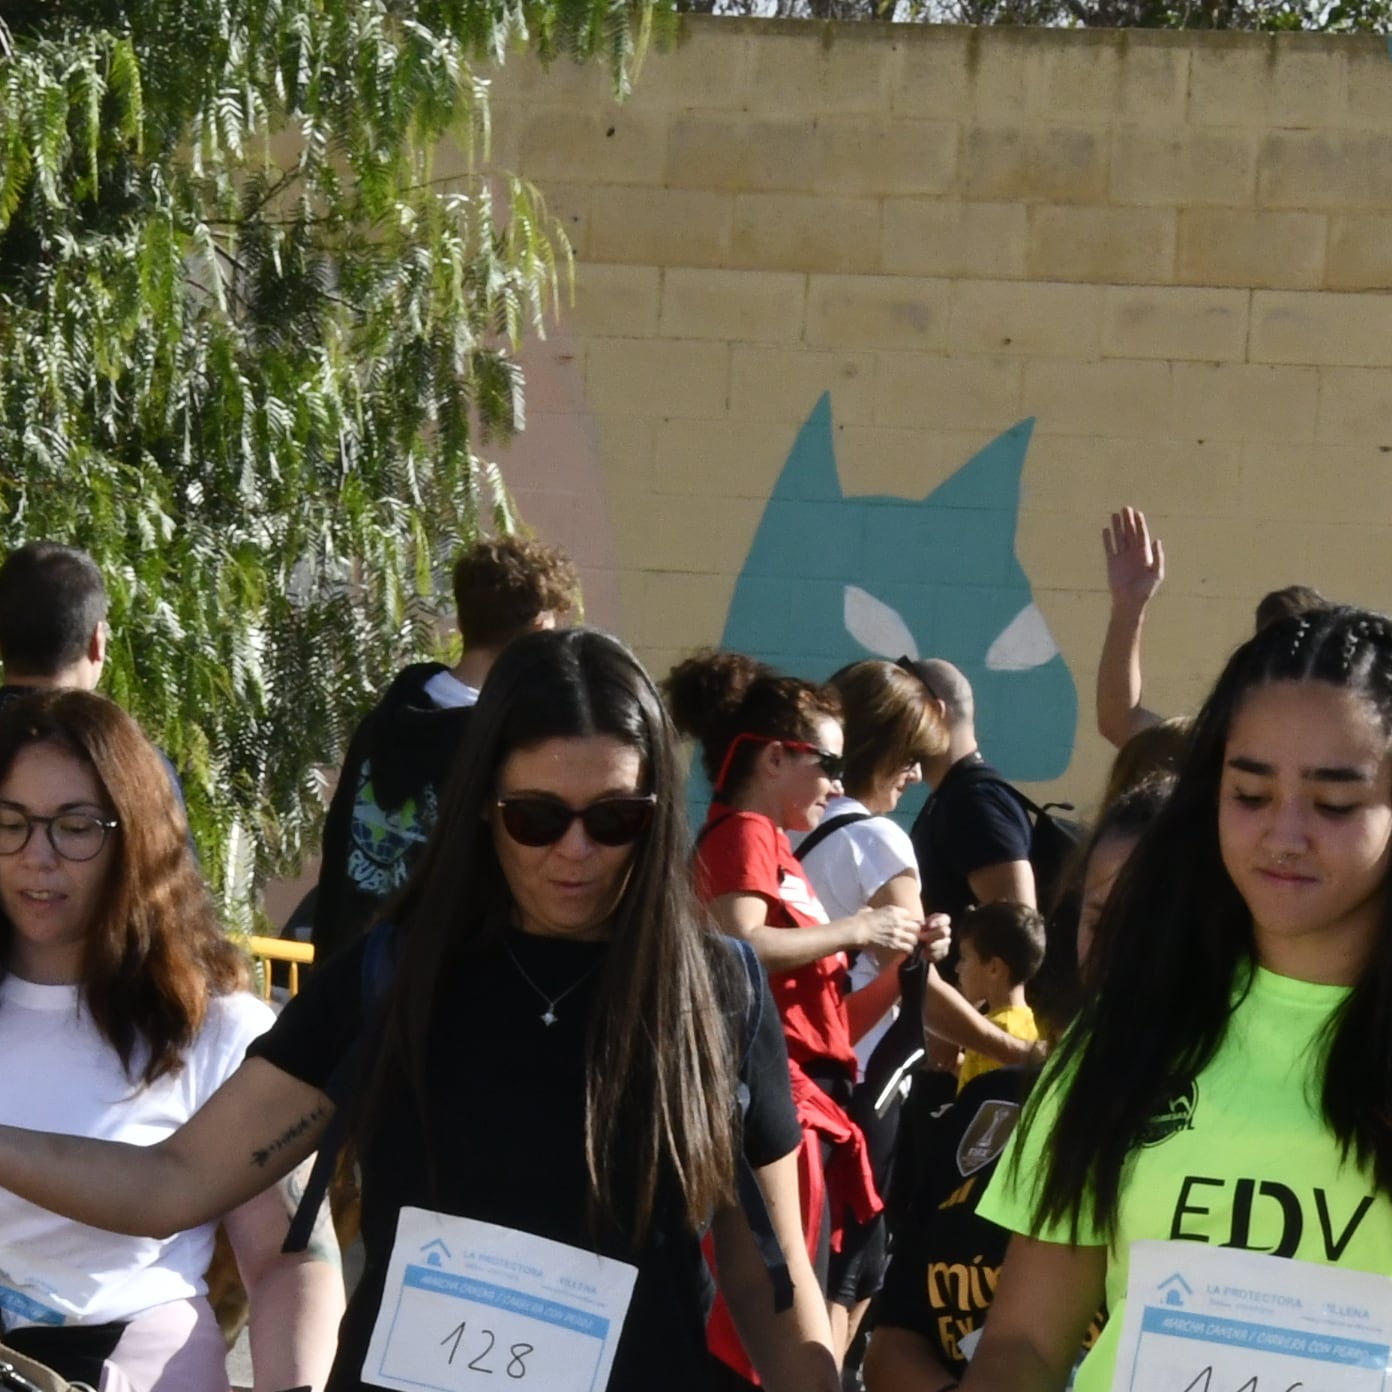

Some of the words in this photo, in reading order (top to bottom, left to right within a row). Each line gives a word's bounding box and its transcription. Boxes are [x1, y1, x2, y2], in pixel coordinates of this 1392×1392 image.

[1169, 1175, 1376, 1261] EDV
[1207, 1284, 1219, 1296] LA
[1222, 1286, 1303, 1308] PROTECTORA
[440, 1320, 535, 1379] 128
